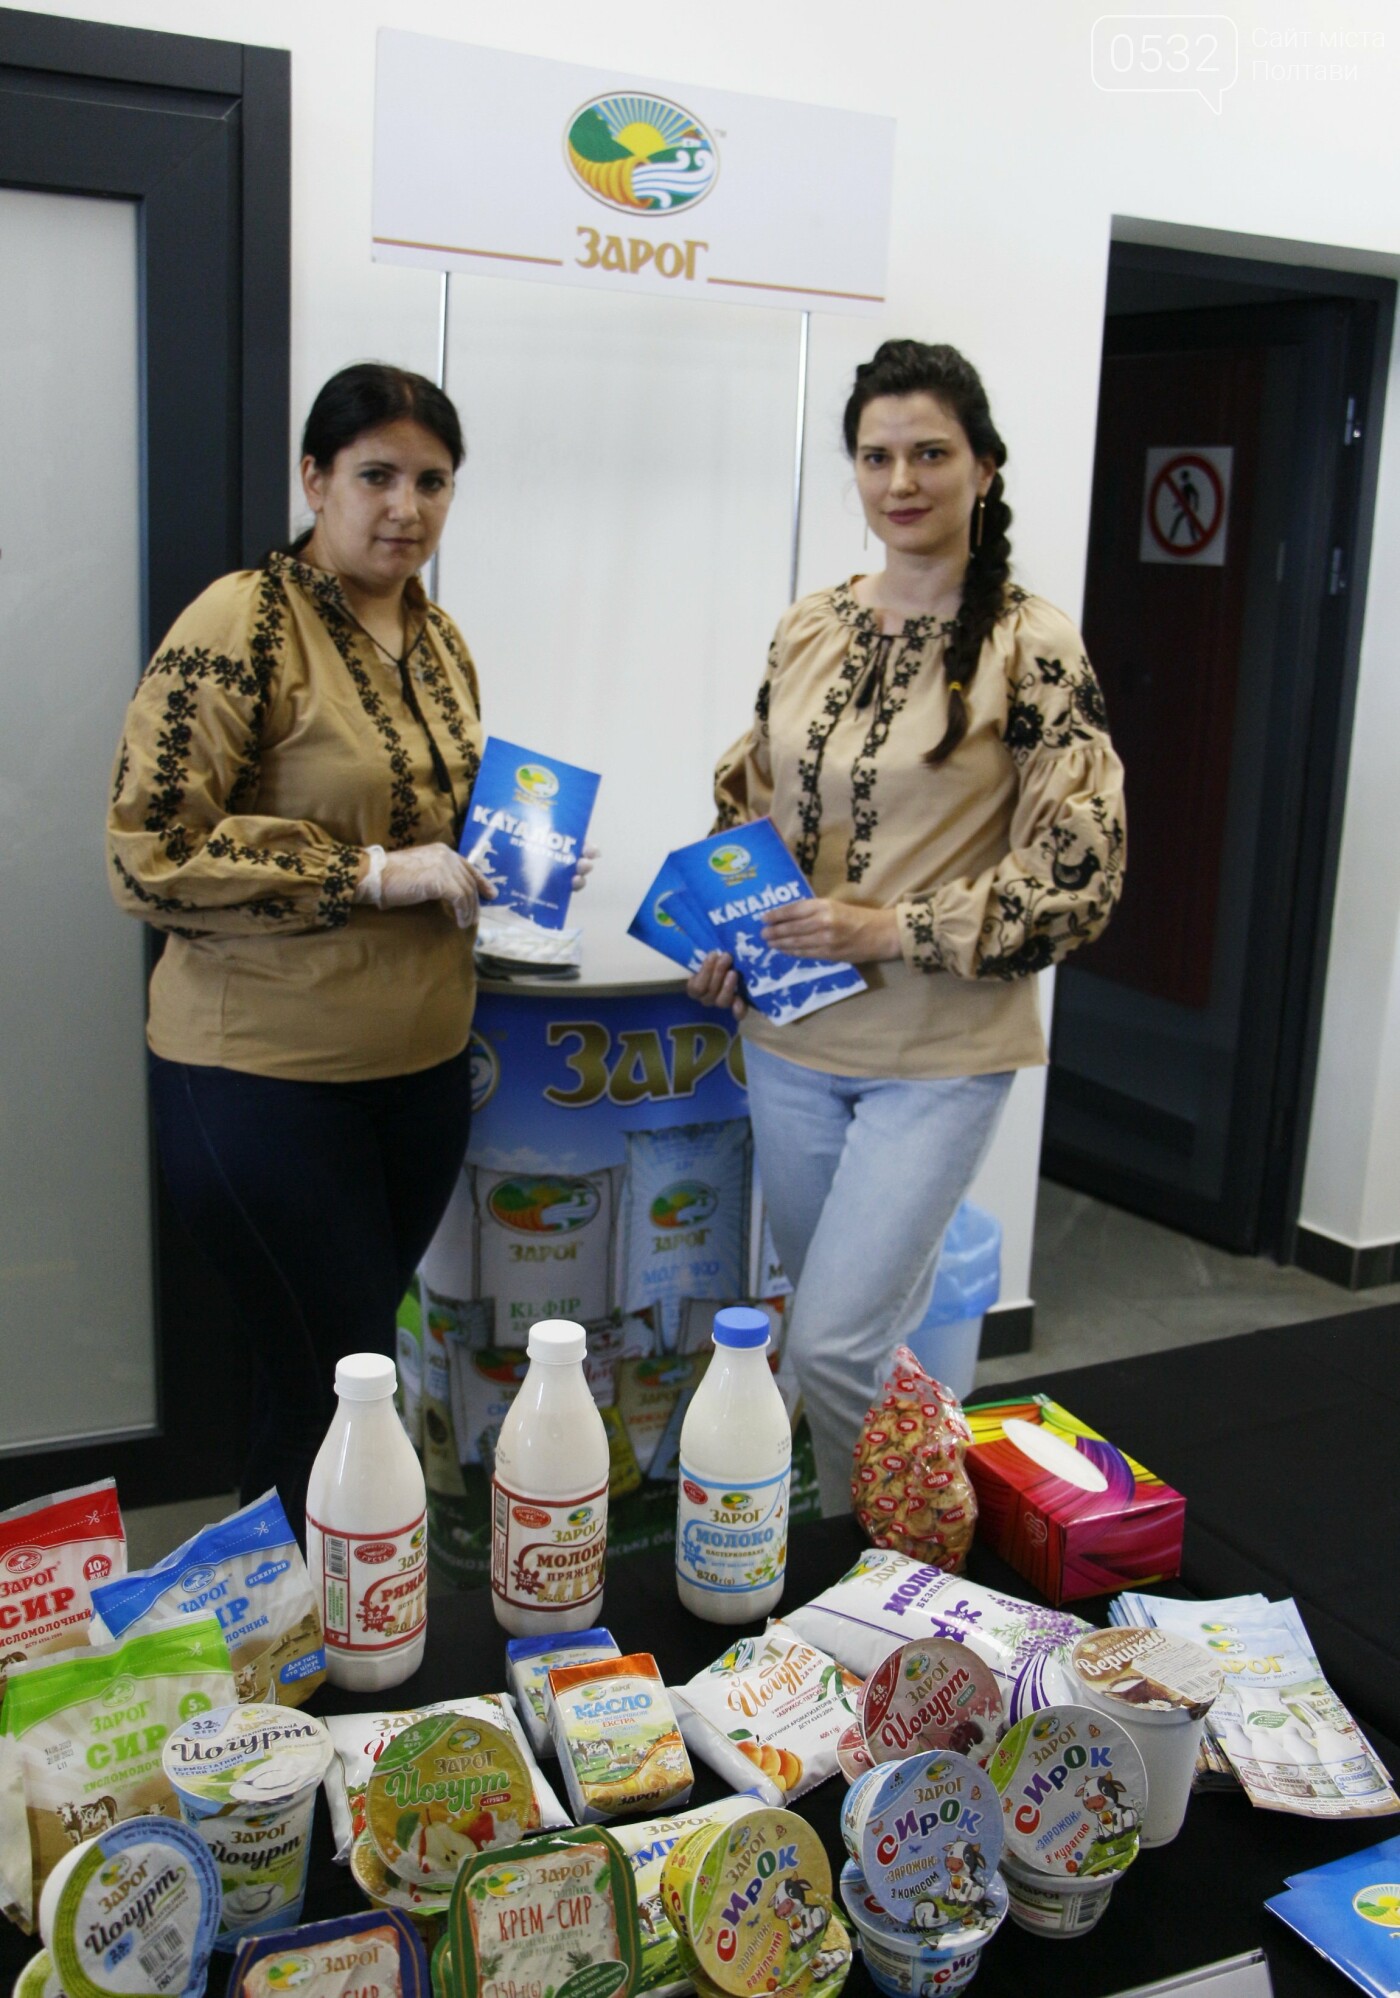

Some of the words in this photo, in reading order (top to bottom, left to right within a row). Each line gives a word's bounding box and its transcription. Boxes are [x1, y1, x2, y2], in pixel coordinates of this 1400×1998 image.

[575, 226, 709, 281] ЗАРОГ
[472, 804, 578, 855] КАТАОГ
[707, 881, 801, 926] КАТАЛОГ
[551, 1517, 600, 1543] ЗАРОГ
[709, 1508, 764, 1524] ЗАРОГ
[695, 1527, 774, 1548] МОЛОКО
[0, 1566, 57, 1598] ЗАРОГ
[696, 1570, 719, 1584] 870
[0, 1586, 75, 1631] СИР
[531, 1656, 603, 1677] МАС
[1075, 1630, 1166, 1676] Вершки
[905, 1656, 951, 1707] ЗАРОГ
[91, 1700, 149, 1734] ЗАРОГ
[372, 1709, 464, 1732] ЗАР
[572, 1693, 653, 1720] МАСЛО
[602, 1717, 636, 1728] ЕКСТРА
[881, 1668, 970, 1750] Йогурт
[86, 1723, 168, 1771] СИР
[171, 1724, 320, 1762] Йогурт
[1028, 1721, 1077, 1768] ЗАРОГ
[82, 1758, 163, 1794] КИСЛОМОЛОЧ
[434, 1749, 497, 1776] ЗАРОГ
[1338, 1770, 1373, 1782] МОЛОКО
[385, 1762, 512, 1813] Йогурт
[913, 1775, 966, 1804] ЗАРОГ
[1014, 1744, 1113, 1835] СИРОК
[231, 1820, 291, 1844] ЗАРОГ
[642, 1815, 713, 1836] ЗАРОГ
[876, 1799, 982, 1866] СИРОК
[207, 1835, 302, 1871] Йогурт
[725, 1826, 765, 1886] ЗАРОГ
[98, 1858, 149, 1914] ЗАРОГ
[536, 1860, 596, 1885] ЗАРОГ
[84, 1869, 181, 1955] Йогурт
[716, 1845, 798, 1962] СИРОК
[320, 1944, 385, 1974] ЗАРОГ
